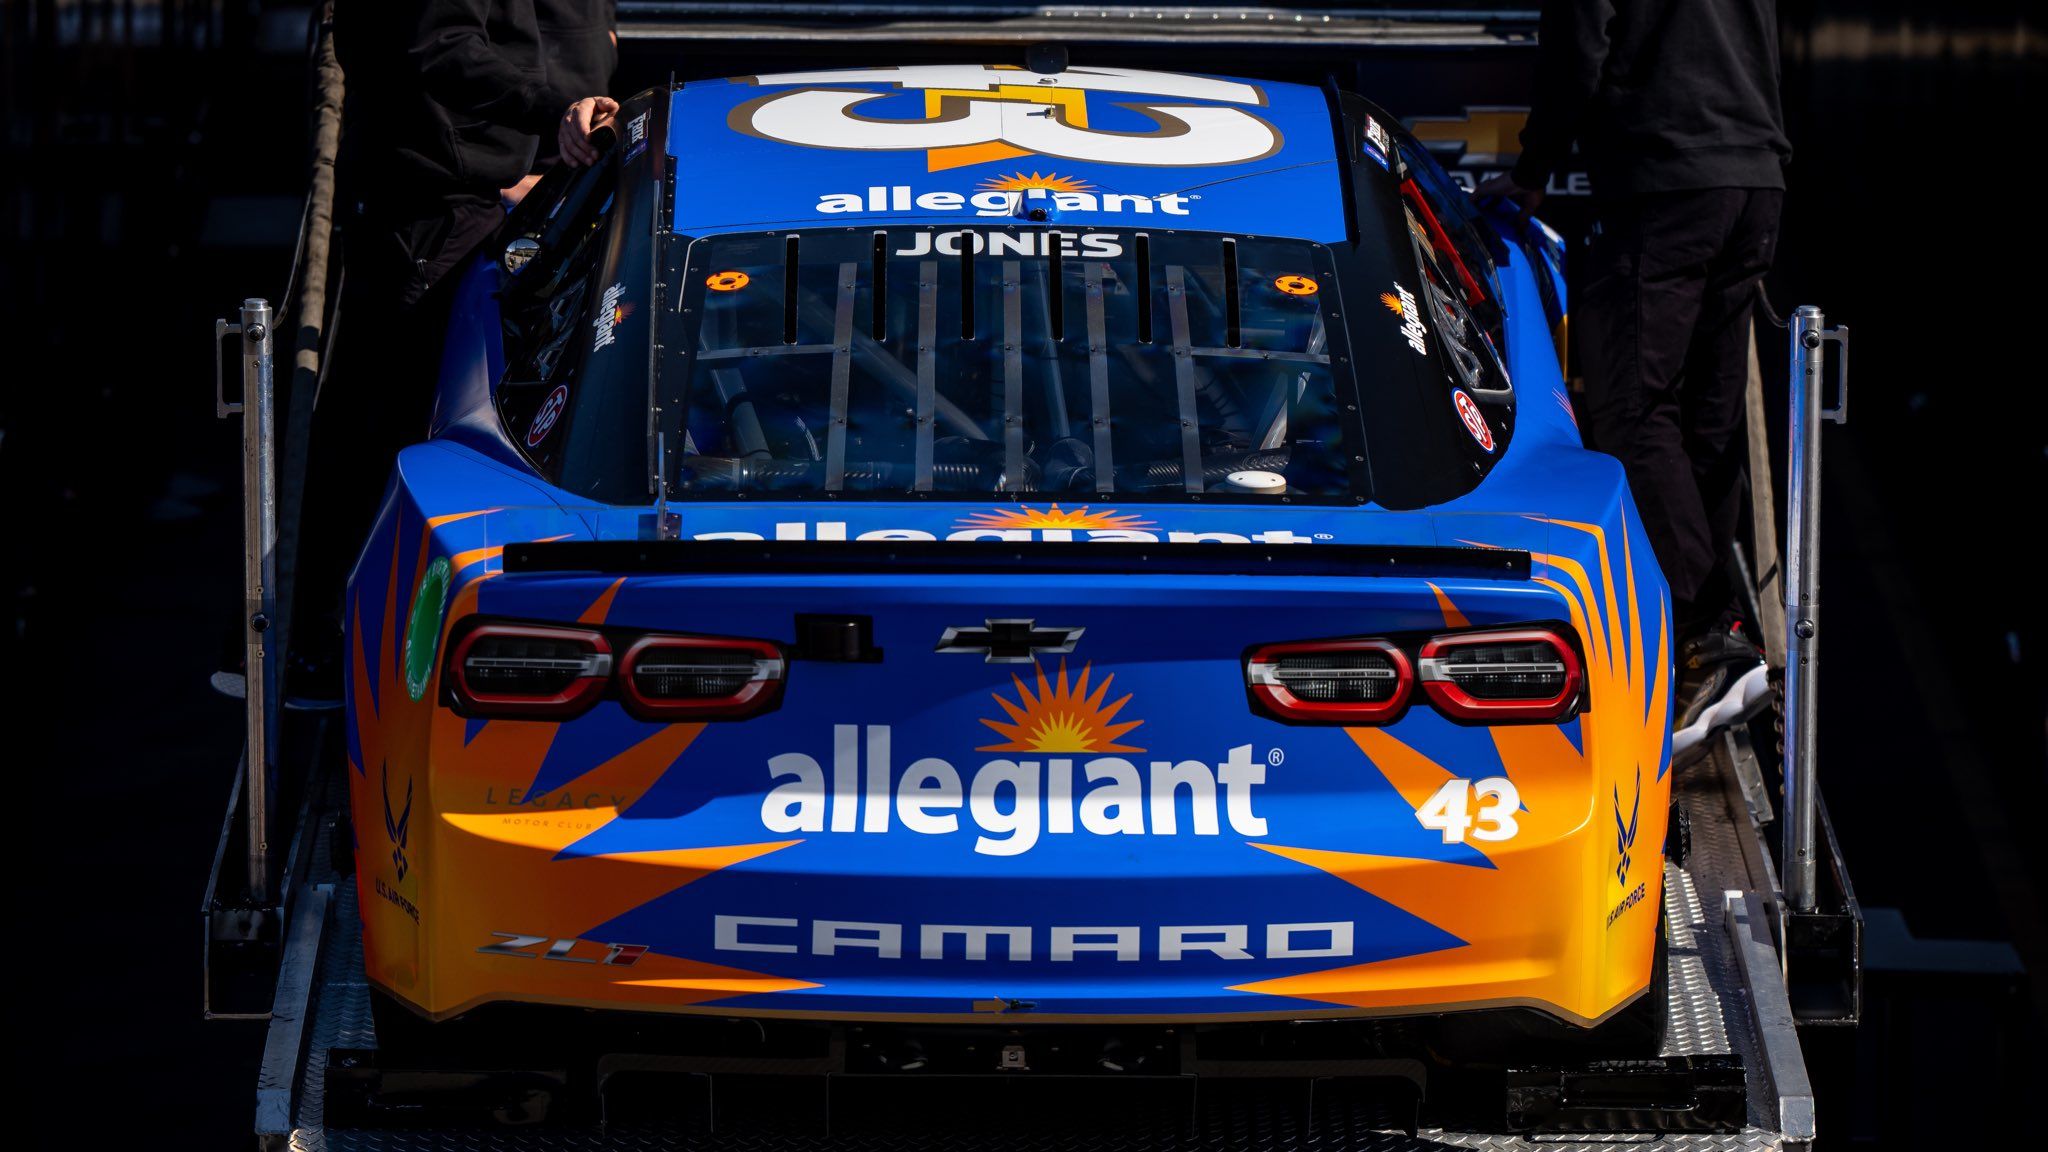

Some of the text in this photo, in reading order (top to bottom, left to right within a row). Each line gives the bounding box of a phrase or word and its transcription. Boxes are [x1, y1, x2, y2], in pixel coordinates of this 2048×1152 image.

[895, 232, 1123, 258] JONES
[533, 391, 563, 434] STP
[1458, 396, 1488, 442] STP
[485, 786, 627, 813] LEGACY
[1415, 776, 1520, 844] 43
[502, 817, 593, 830] MOTOR CLUB
[388, 887, 401, 907] AIR
[400, 895, 420, 926] FORCE
[1624, 882, 1646, 912] FORCE
[475, 931, 650, 967] ZL1
[714, 914, 1355, 962] CAMARO
